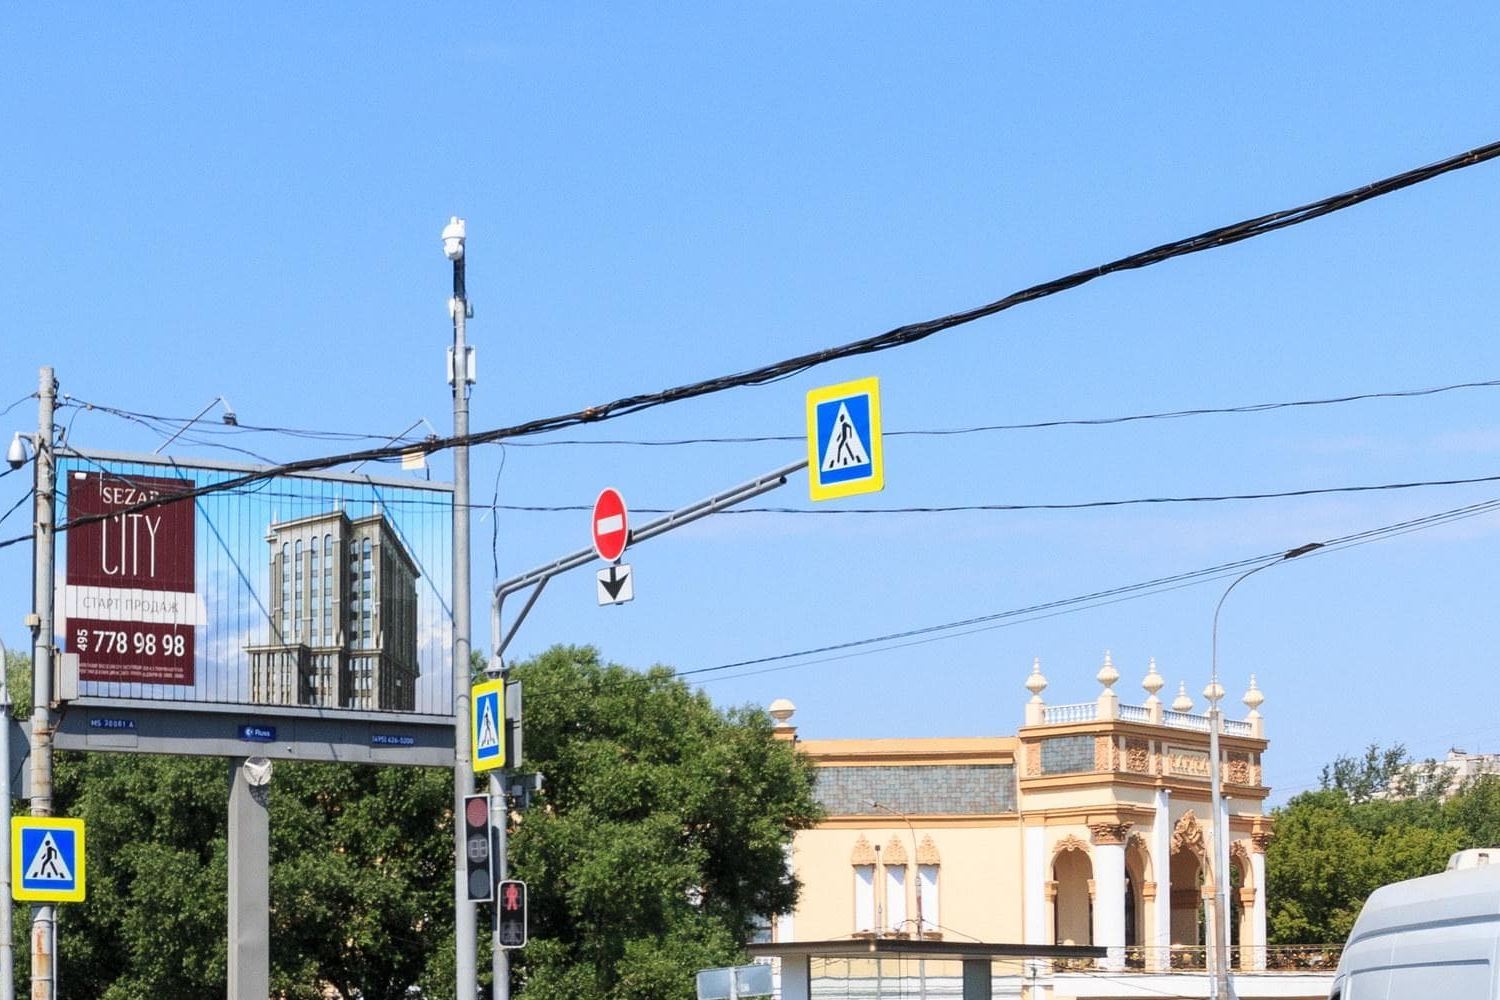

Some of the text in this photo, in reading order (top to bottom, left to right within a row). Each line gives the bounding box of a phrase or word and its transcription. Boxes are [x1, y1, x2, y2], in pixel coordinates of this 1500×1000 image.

[102, 509, 161, 578] CITY
[82, 596, 180, 614] СТАРТ ПРОДАЖ
[76, 628, 88, 652] 495
[92, 630, 186, 657] 778 98 98
